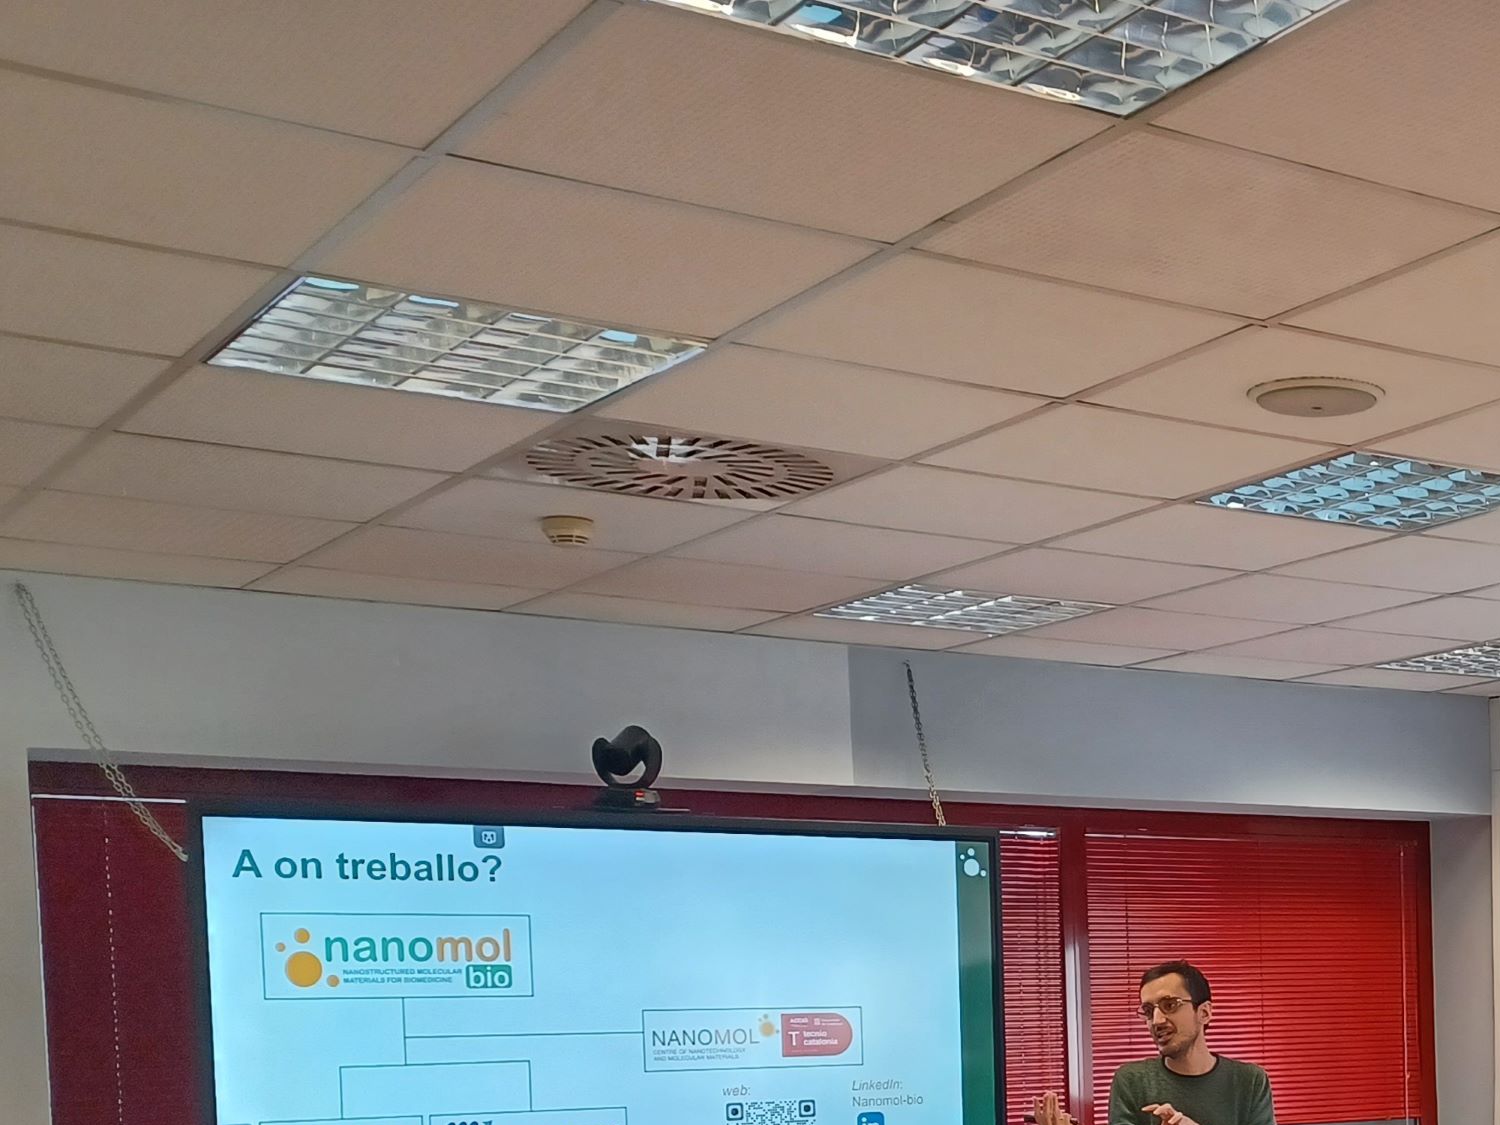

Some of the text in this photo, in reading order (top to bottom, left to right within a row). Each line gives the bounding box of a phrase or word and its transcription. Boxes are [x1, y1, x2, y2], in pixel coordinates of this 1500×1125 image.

[232, 849, 501, 882] A on treballo?
[325, 928, 511, 962] nanomol
[469, 966, 510, 988] bio
[652, 1028, 760, 1047] NANOMOL
[788, 1031, 800, 1046] T
[722, 1085, 751, 1096] web:
[852, 1080, 903, 1091] LinkedIn:
[852, 1094, 923, 1107] Nanomol-bio
